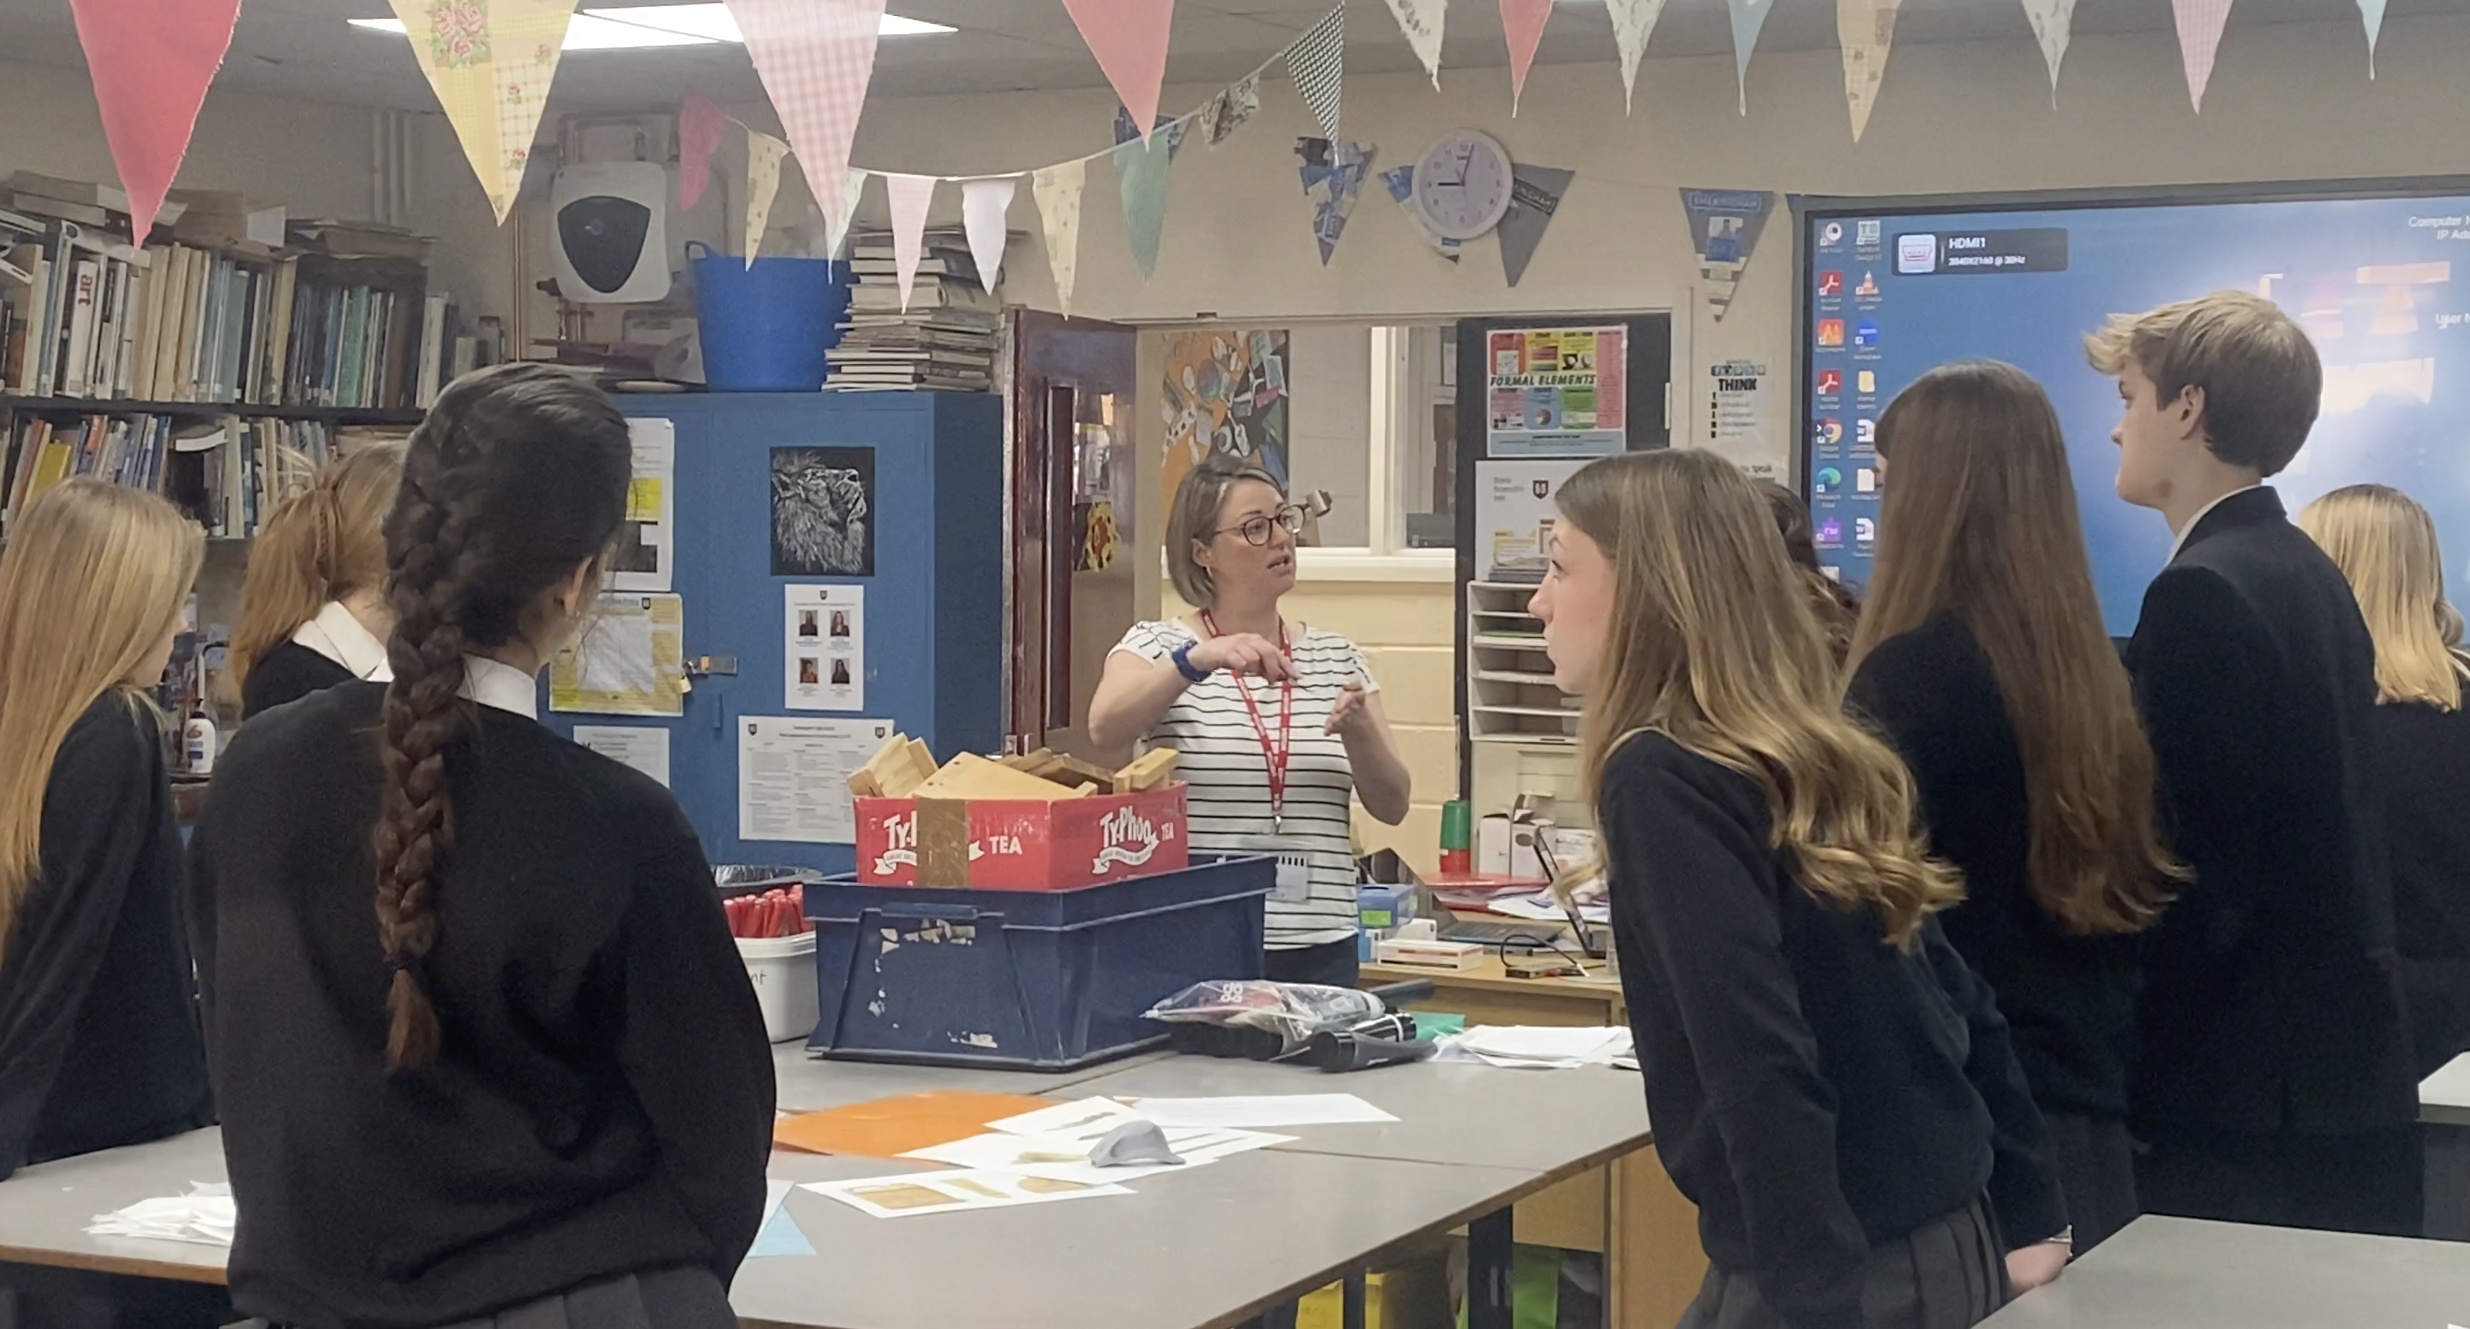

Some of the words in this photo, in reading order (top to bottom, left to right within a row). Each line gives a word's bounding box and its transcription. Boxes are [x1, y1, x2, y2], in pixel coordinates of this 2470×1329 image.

[2408, 216, 2462, 228] Computer
[2437, 229, 2450, 240] IP
[1948, 237, 1986, 249] HDMI1
[78, 273, 93, 307] art
[1490, 374, 1535, 387] FORMAL
[1538, 374, 1597, 386] ELEMENTS
[1718, 378, 1757, 391] THINK
[1161, 822, 1175, 841] TEA
[988, 836, 1023, 855] TEA
